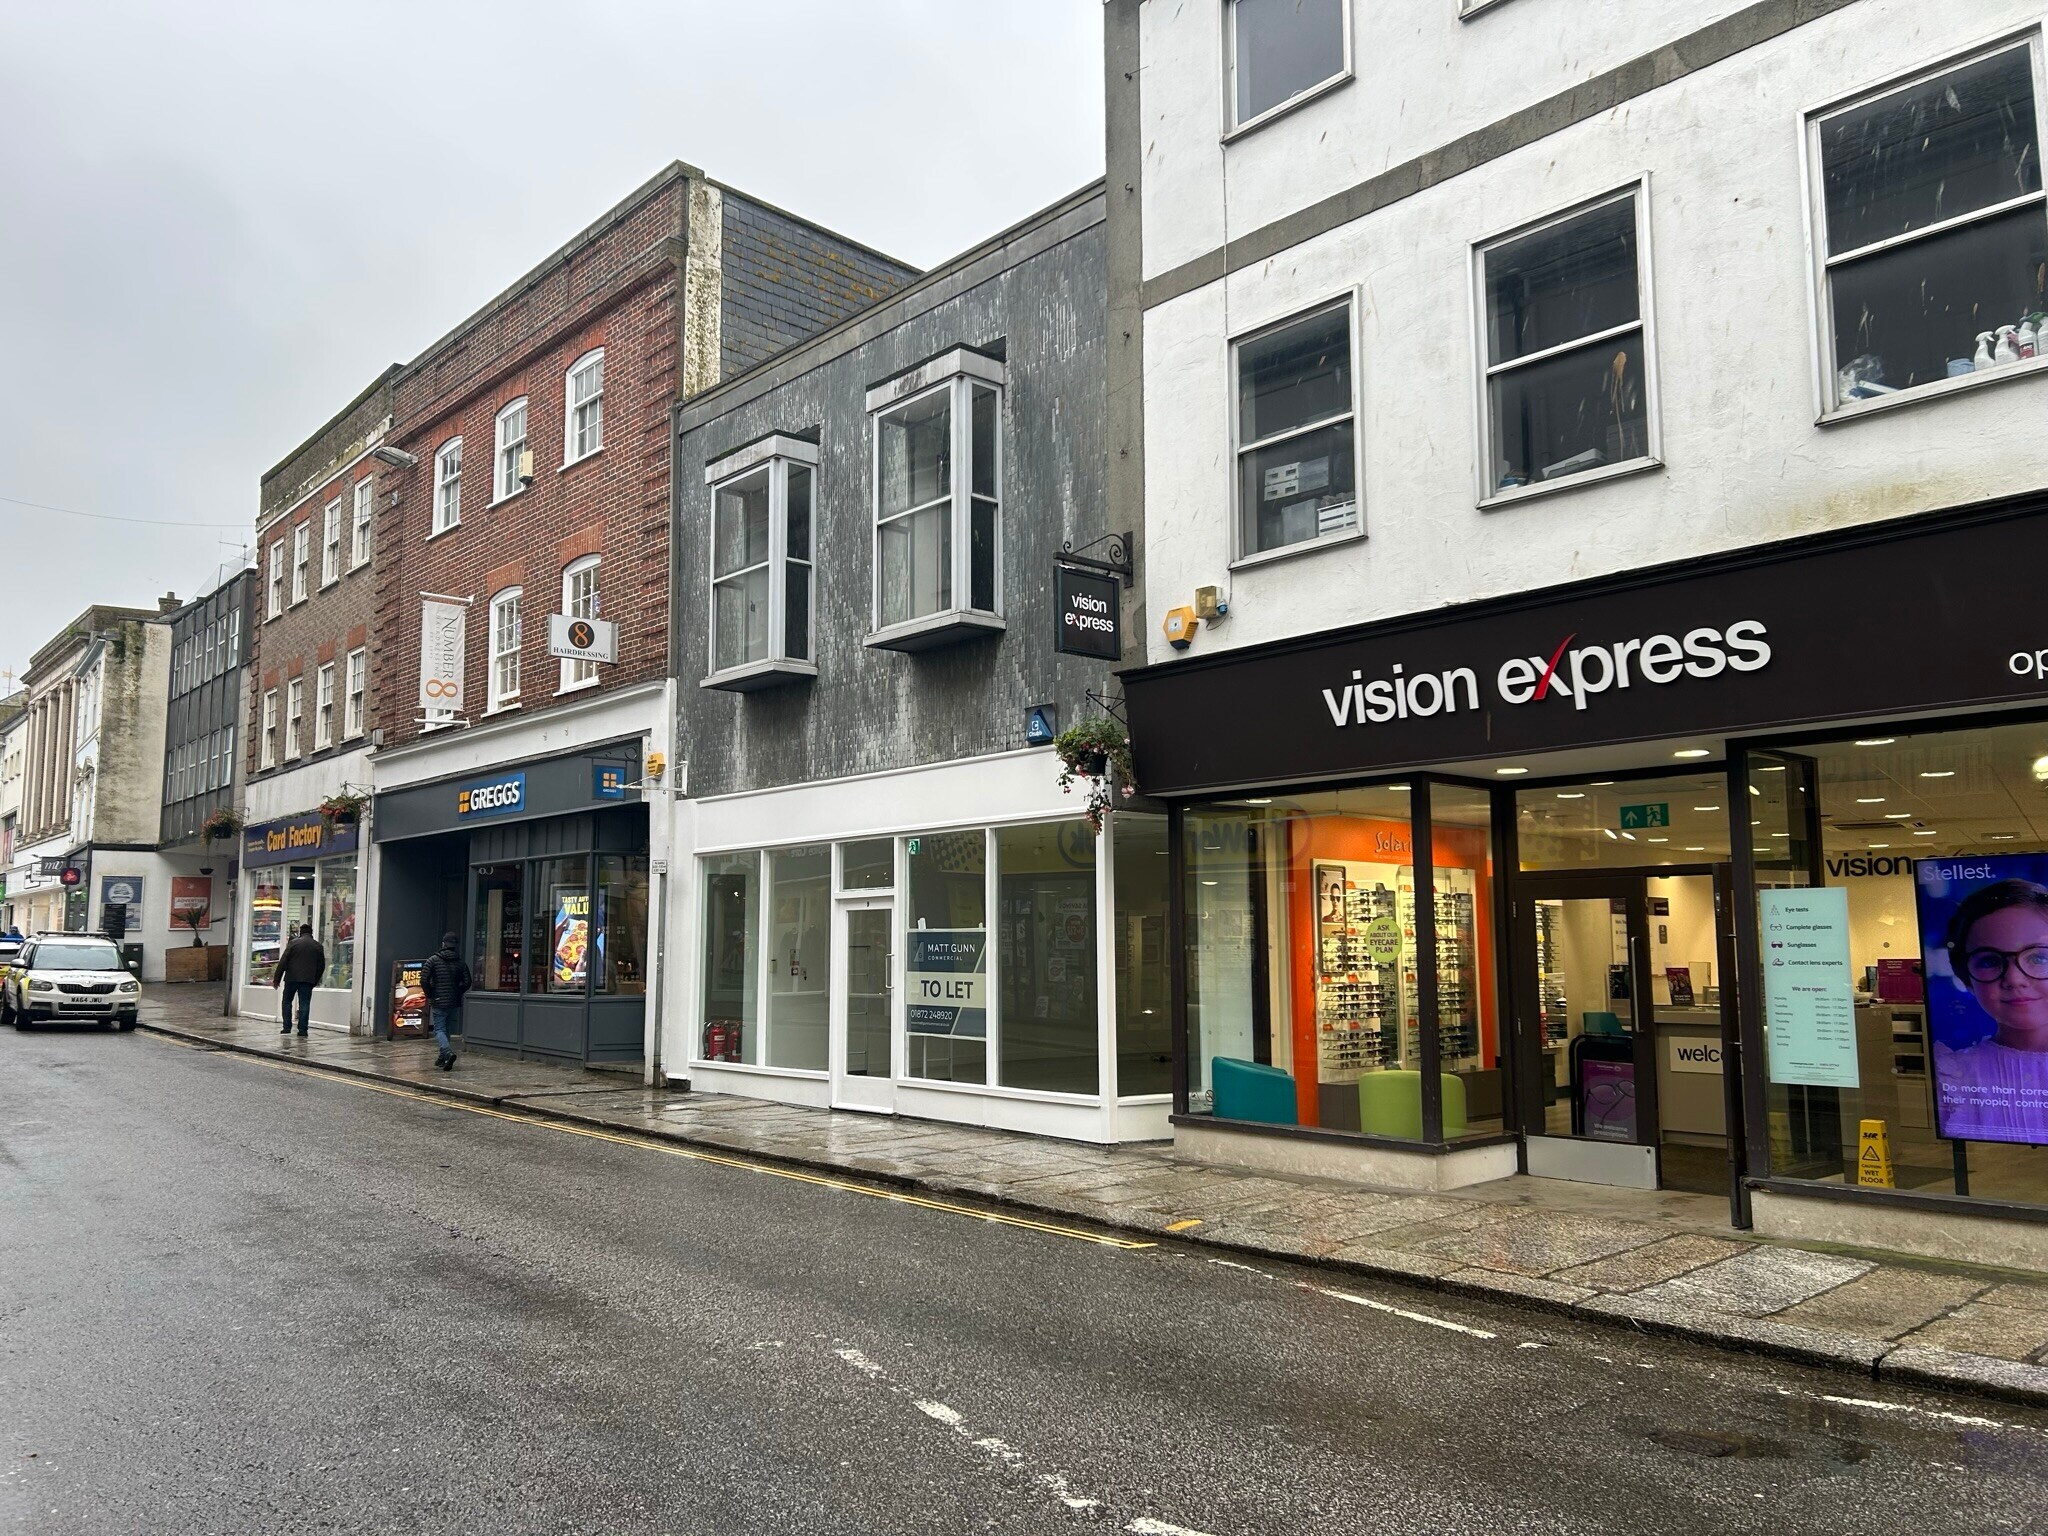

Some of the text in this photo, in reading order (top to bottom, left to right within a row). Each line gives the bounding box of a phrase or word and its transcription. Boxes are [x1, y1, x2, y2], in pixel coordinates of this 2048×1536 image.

[1071, 593, 1107, 613] vision
[1065, 612, 1114, 632] express
[574, 623, 589, 647] 8
[426, 616, 458, 698] NUMBER 8
[553, 647, 608, 659] HAIRDRESSING
[1322, 620, 1772, 727] vision express
[470, 781, 520, 811] GREGGS
[267, 828, 287, 852] Card
[288, 823, 322, 849] Factory
[1825, 852, 1912, 878] vision
[927, 944, 975, 953] MATT GUNN
[402, 970, 422, 981] RISE
[920, 980, 973, 999] TO LET
[910, 1009, 953, 1020] 01872 248920
[1677, 1045, 1723, 1062] welc
[1942, 1083, 1957, 1092] Do
[1961, 1085, 1988, 1093] more
[1992, 1086, 2016, 1095] than
[1942, 1095, 1965, 1104] their
